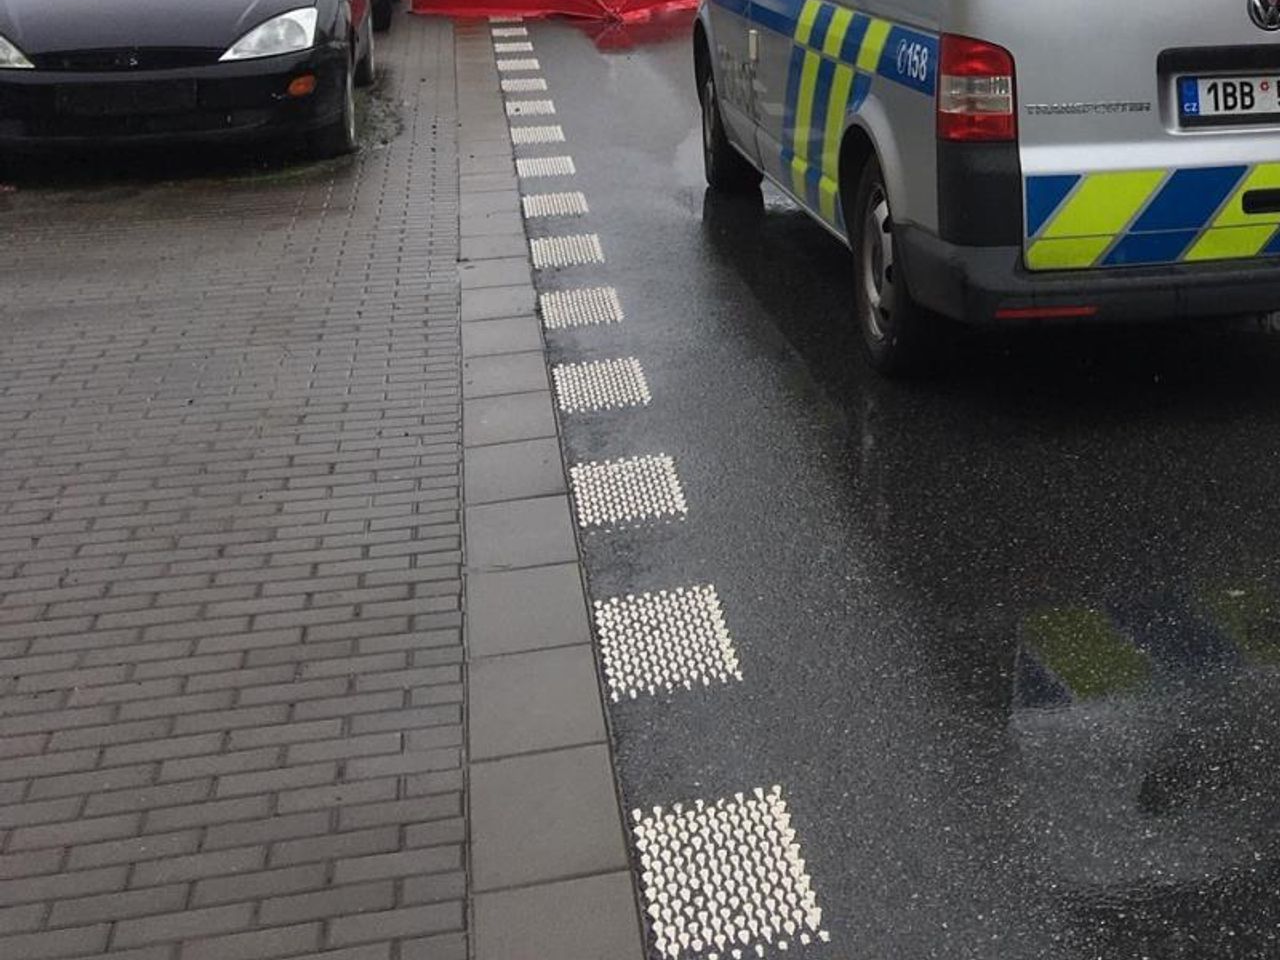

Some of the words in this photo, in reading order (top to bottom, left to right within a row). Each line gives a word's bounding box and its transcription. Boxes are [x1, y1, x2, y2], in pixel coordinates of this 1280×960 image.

[906, 43, 929, 82] 158
[1183, 102, 1198, 113] CZ
[1206, 82, 1255, 111] 1BB
